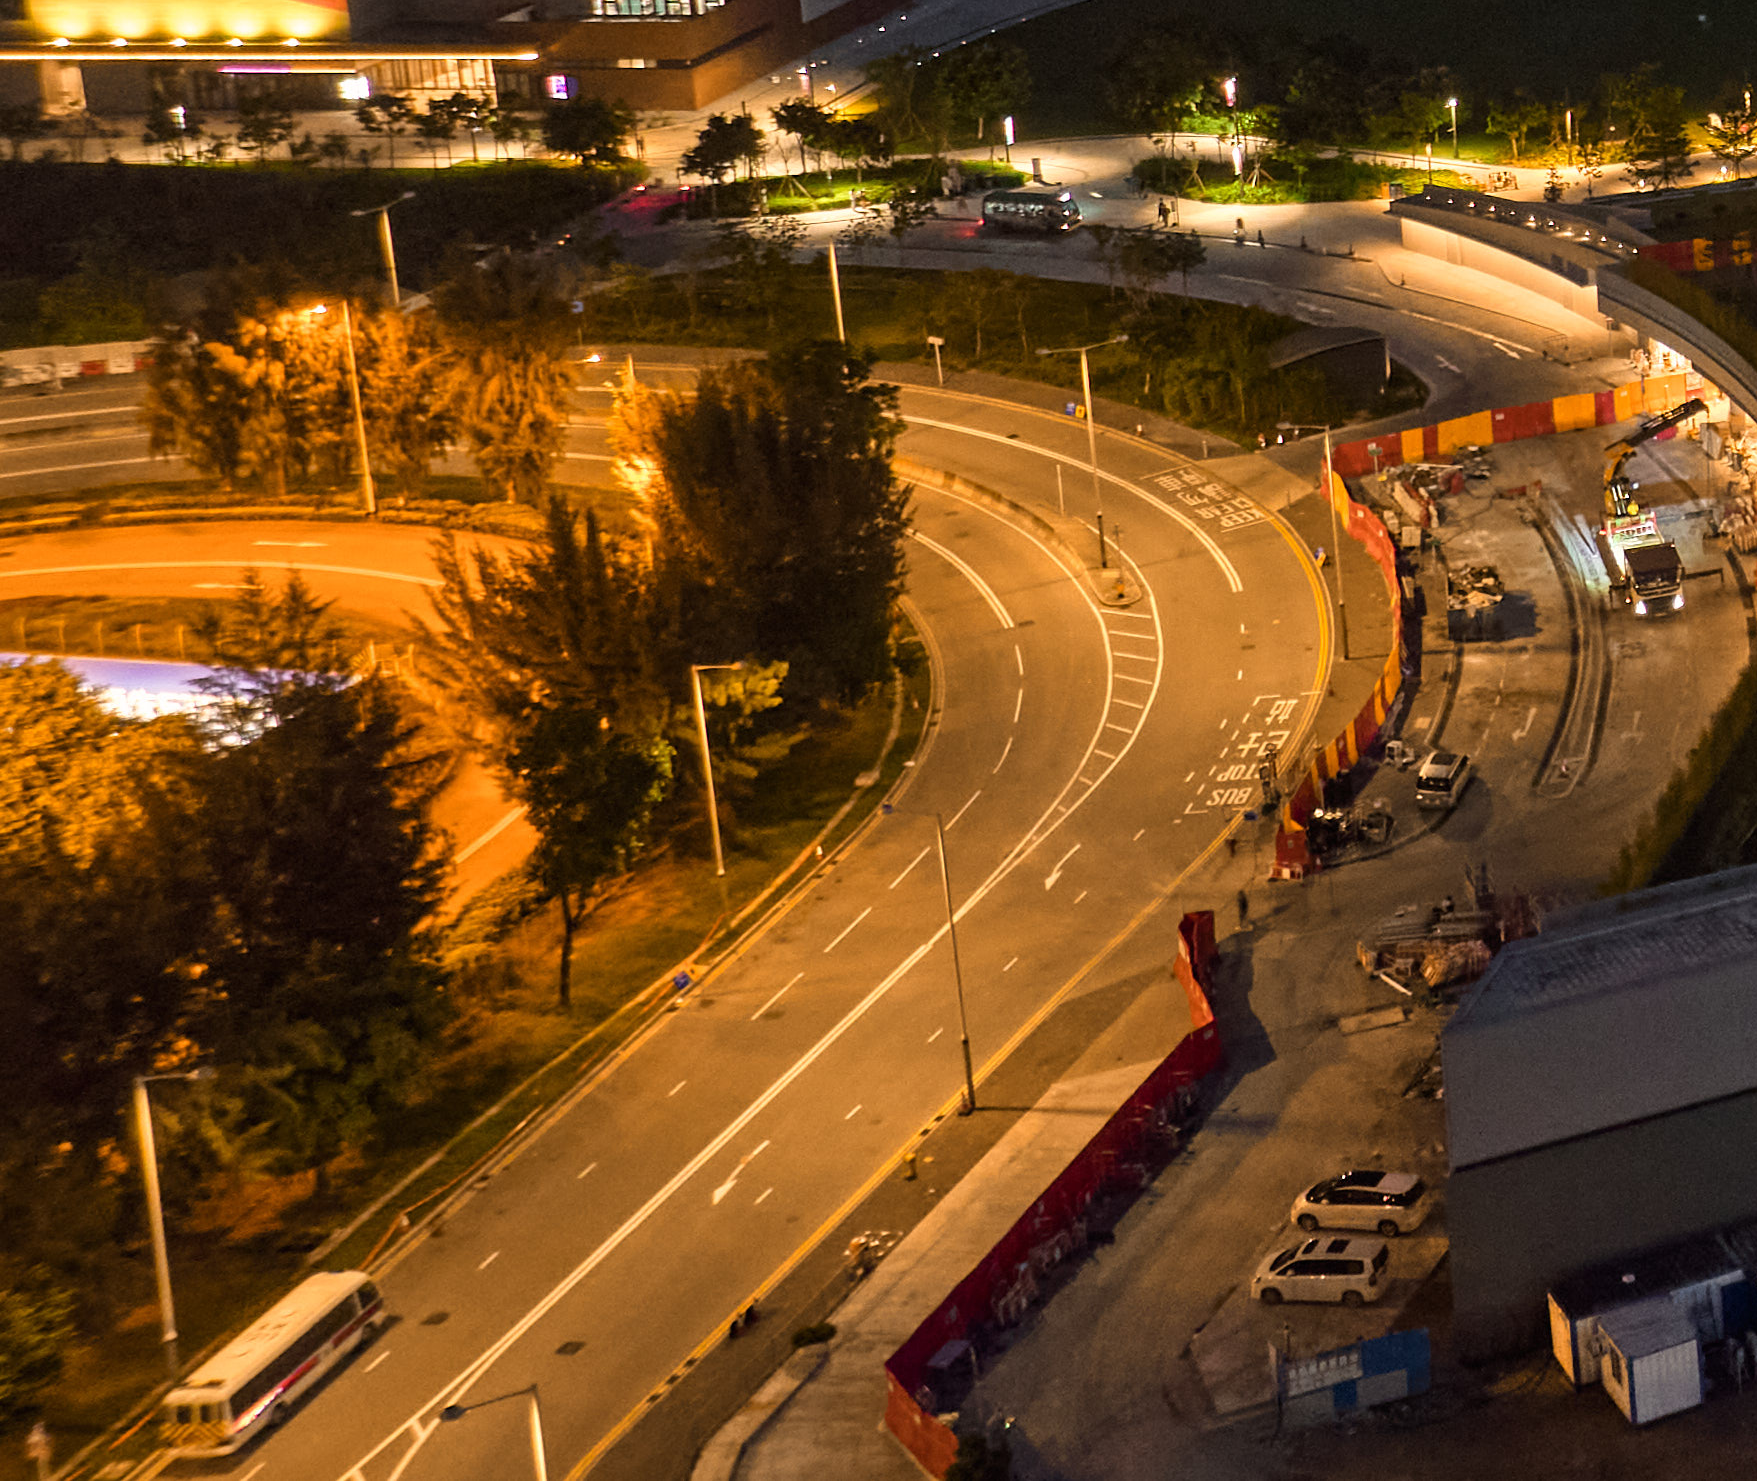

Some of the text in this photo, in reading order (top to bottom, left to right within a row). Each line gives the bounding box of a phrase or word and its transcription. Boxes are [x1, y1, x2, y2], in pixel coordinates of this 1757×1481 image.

[1194, 497, 1254, 519] CLEAR
[1220, 508, 1265, 527] KEEP
[1264, 699, 1299, 725] 站
[1237, 730, 1290, 758] 巴士
[1206, 787, 1253, 806] BUS
